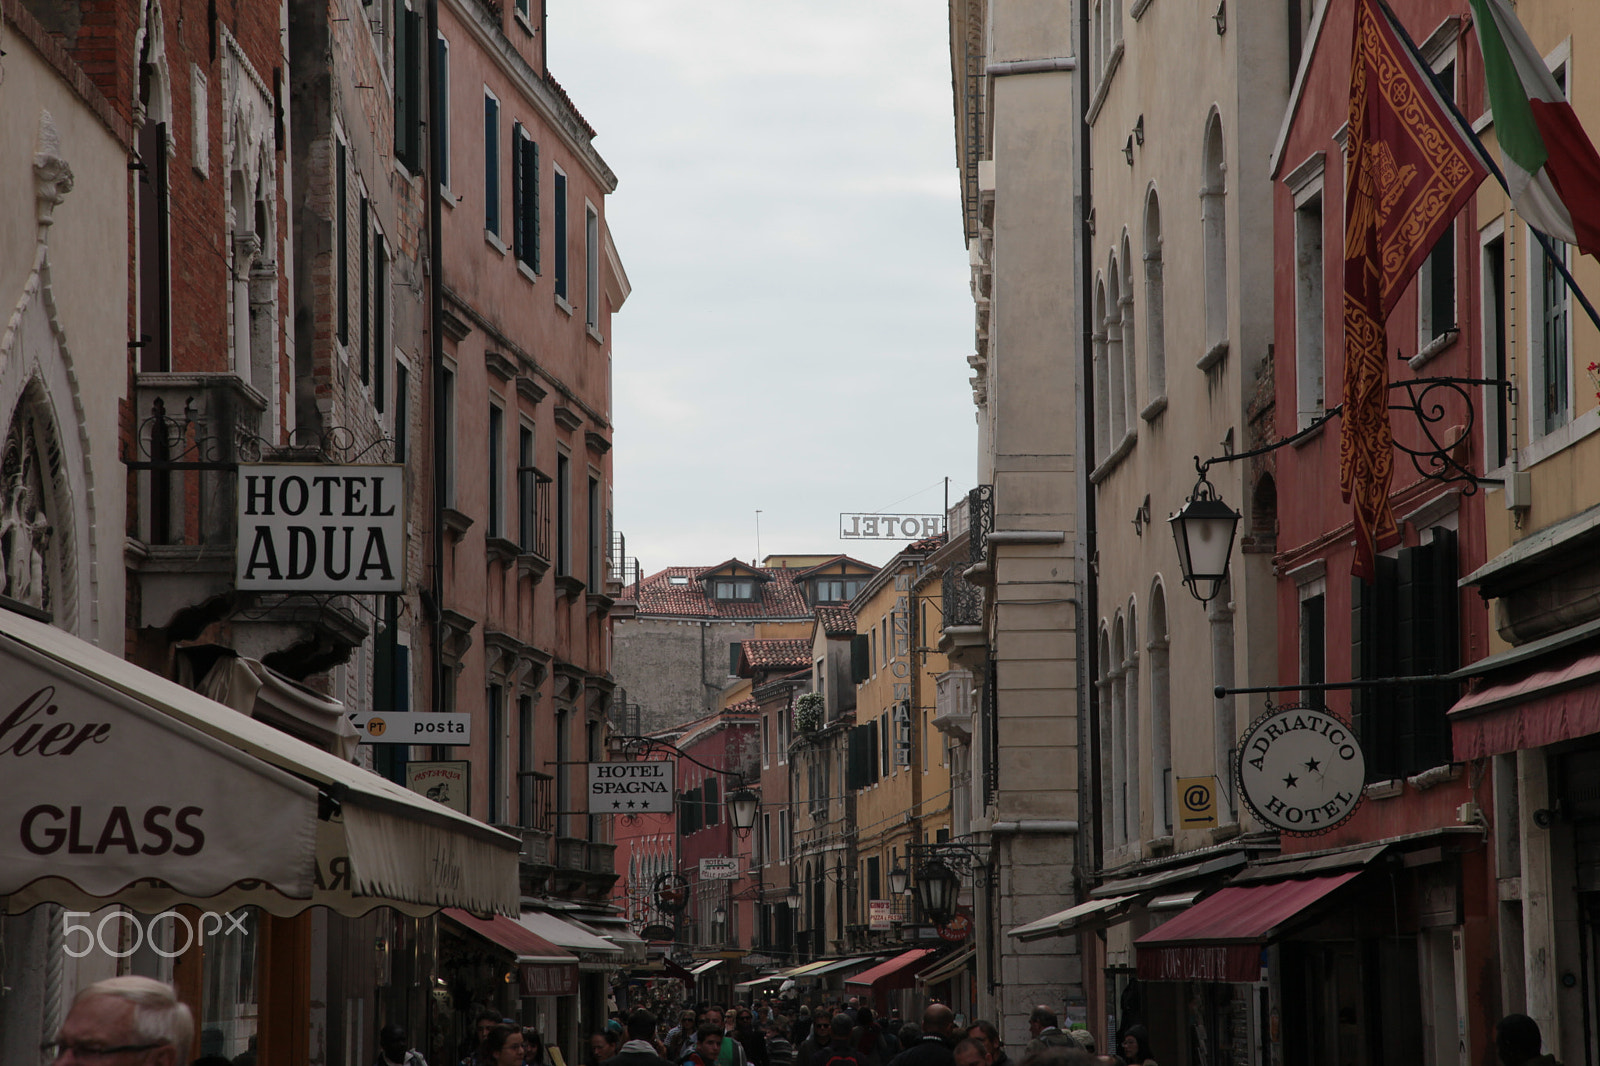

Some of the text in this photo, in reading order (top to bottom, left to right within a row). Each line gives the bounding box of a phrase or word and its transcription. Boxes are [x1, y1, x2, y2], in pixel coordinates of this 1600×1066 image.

[244, 475, 395, 516] HOTEL
[243, 525, 395, 581] ADUA
[370, 720, 465, 735] PT posta
[1248, 715, 1355, 772] ADRIATICO
[414, 769, 461, 781] OSTARIA
[597, 765, 664, 778] HOTEL
[592, 781, 669, 794] SPAGNA
[1184, 784, 1211, 812] @
[1264, 791, 1353, 824] HOTEL
[20, 804, 205, 856] GLASS
